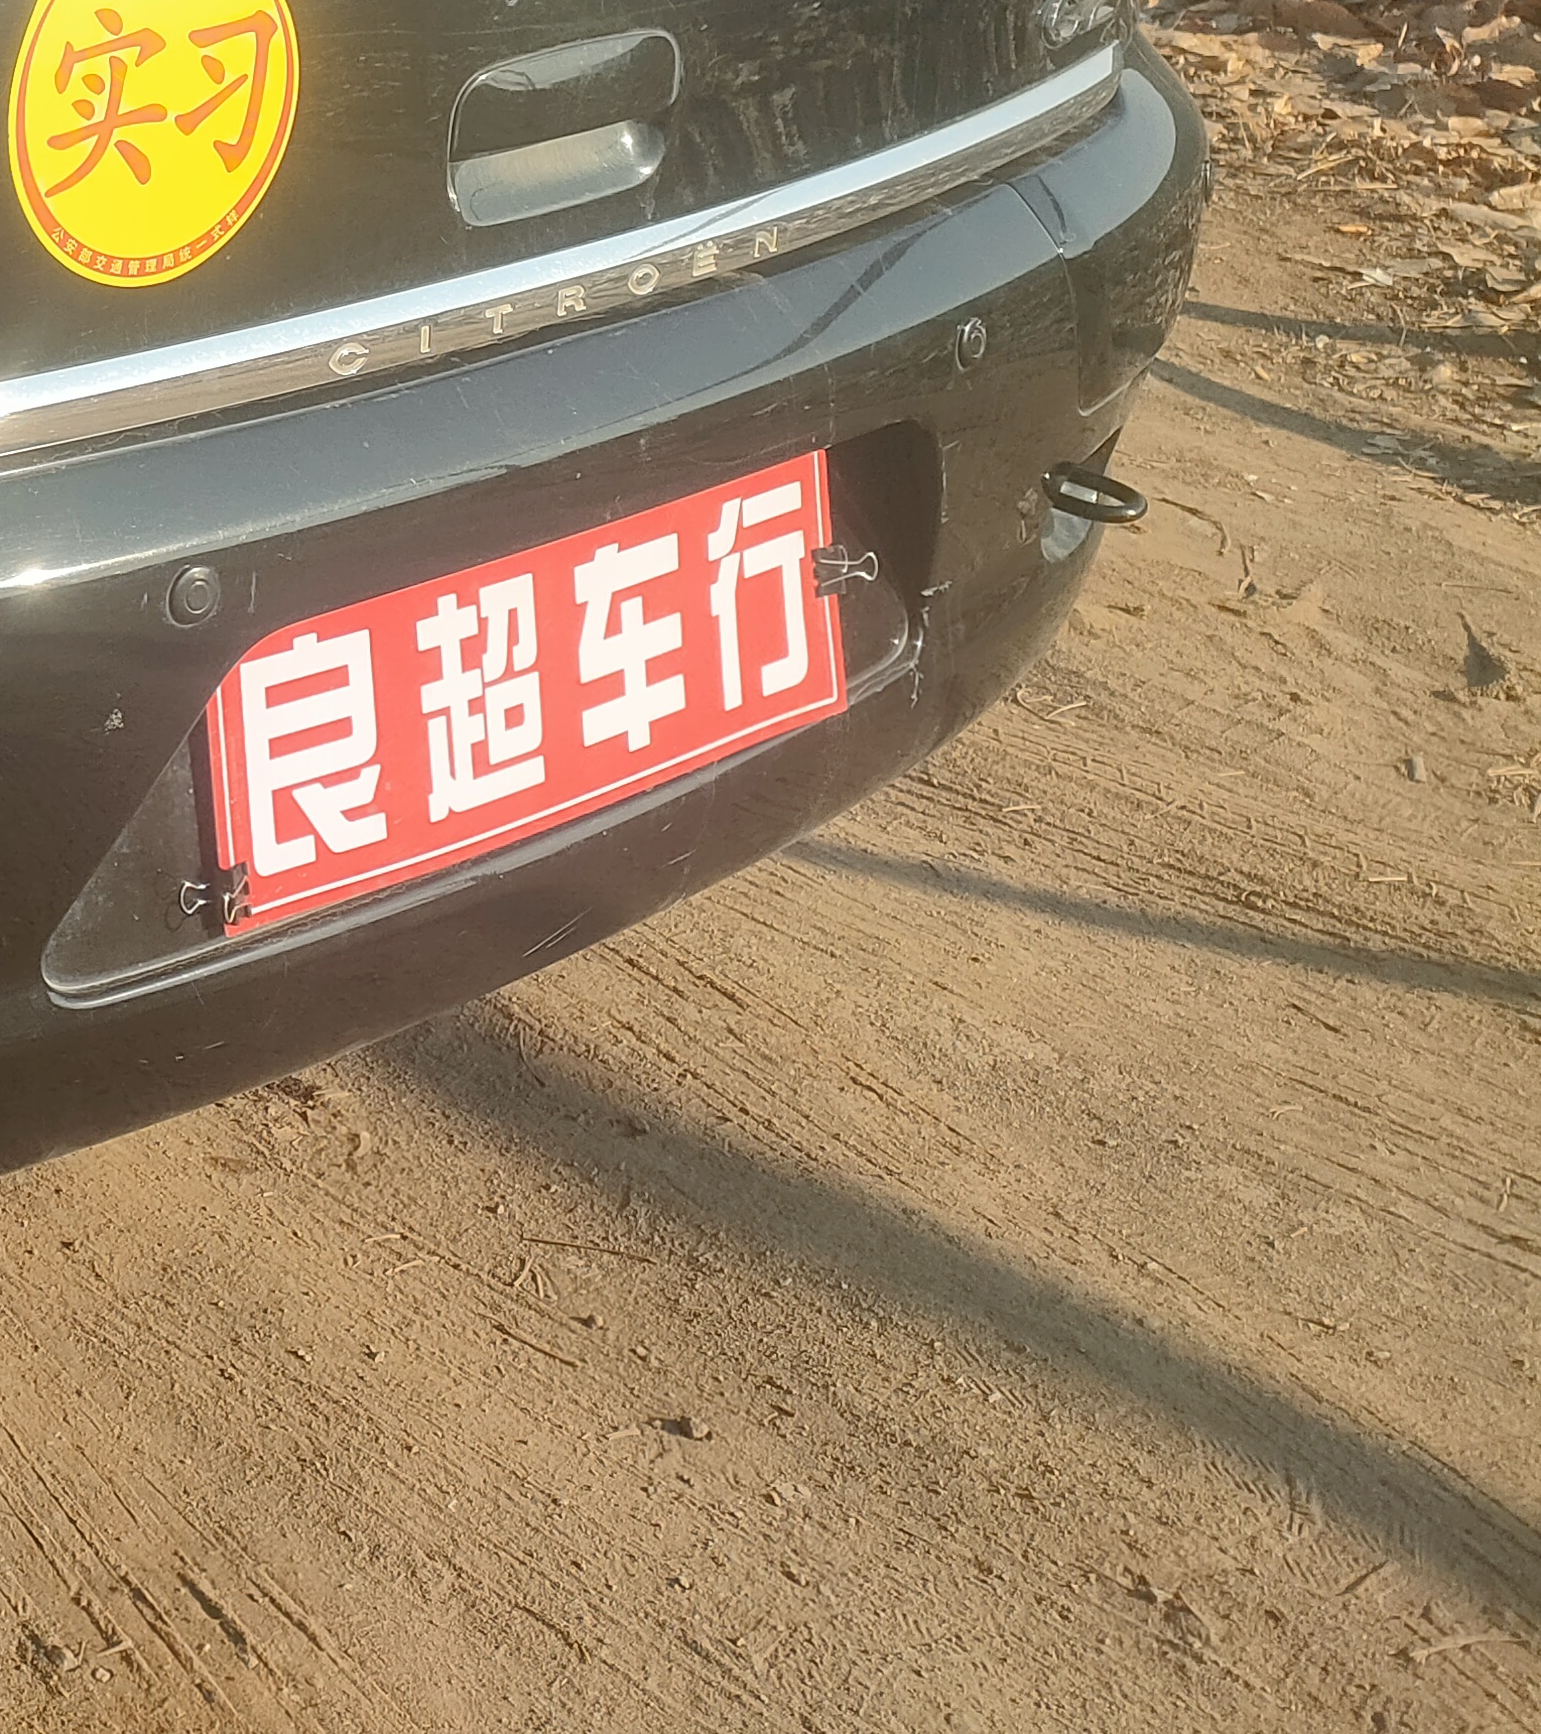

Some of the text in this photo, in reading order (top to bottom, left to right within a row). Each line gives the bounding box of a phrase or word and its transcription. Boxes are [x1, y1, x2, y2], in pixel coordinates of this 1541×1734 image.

[44, 8, 279, 199] 实习
[50, 209, 240, 276] 公安部交通管理局统一式样
[239, 481, 809, 878] 良超车行
